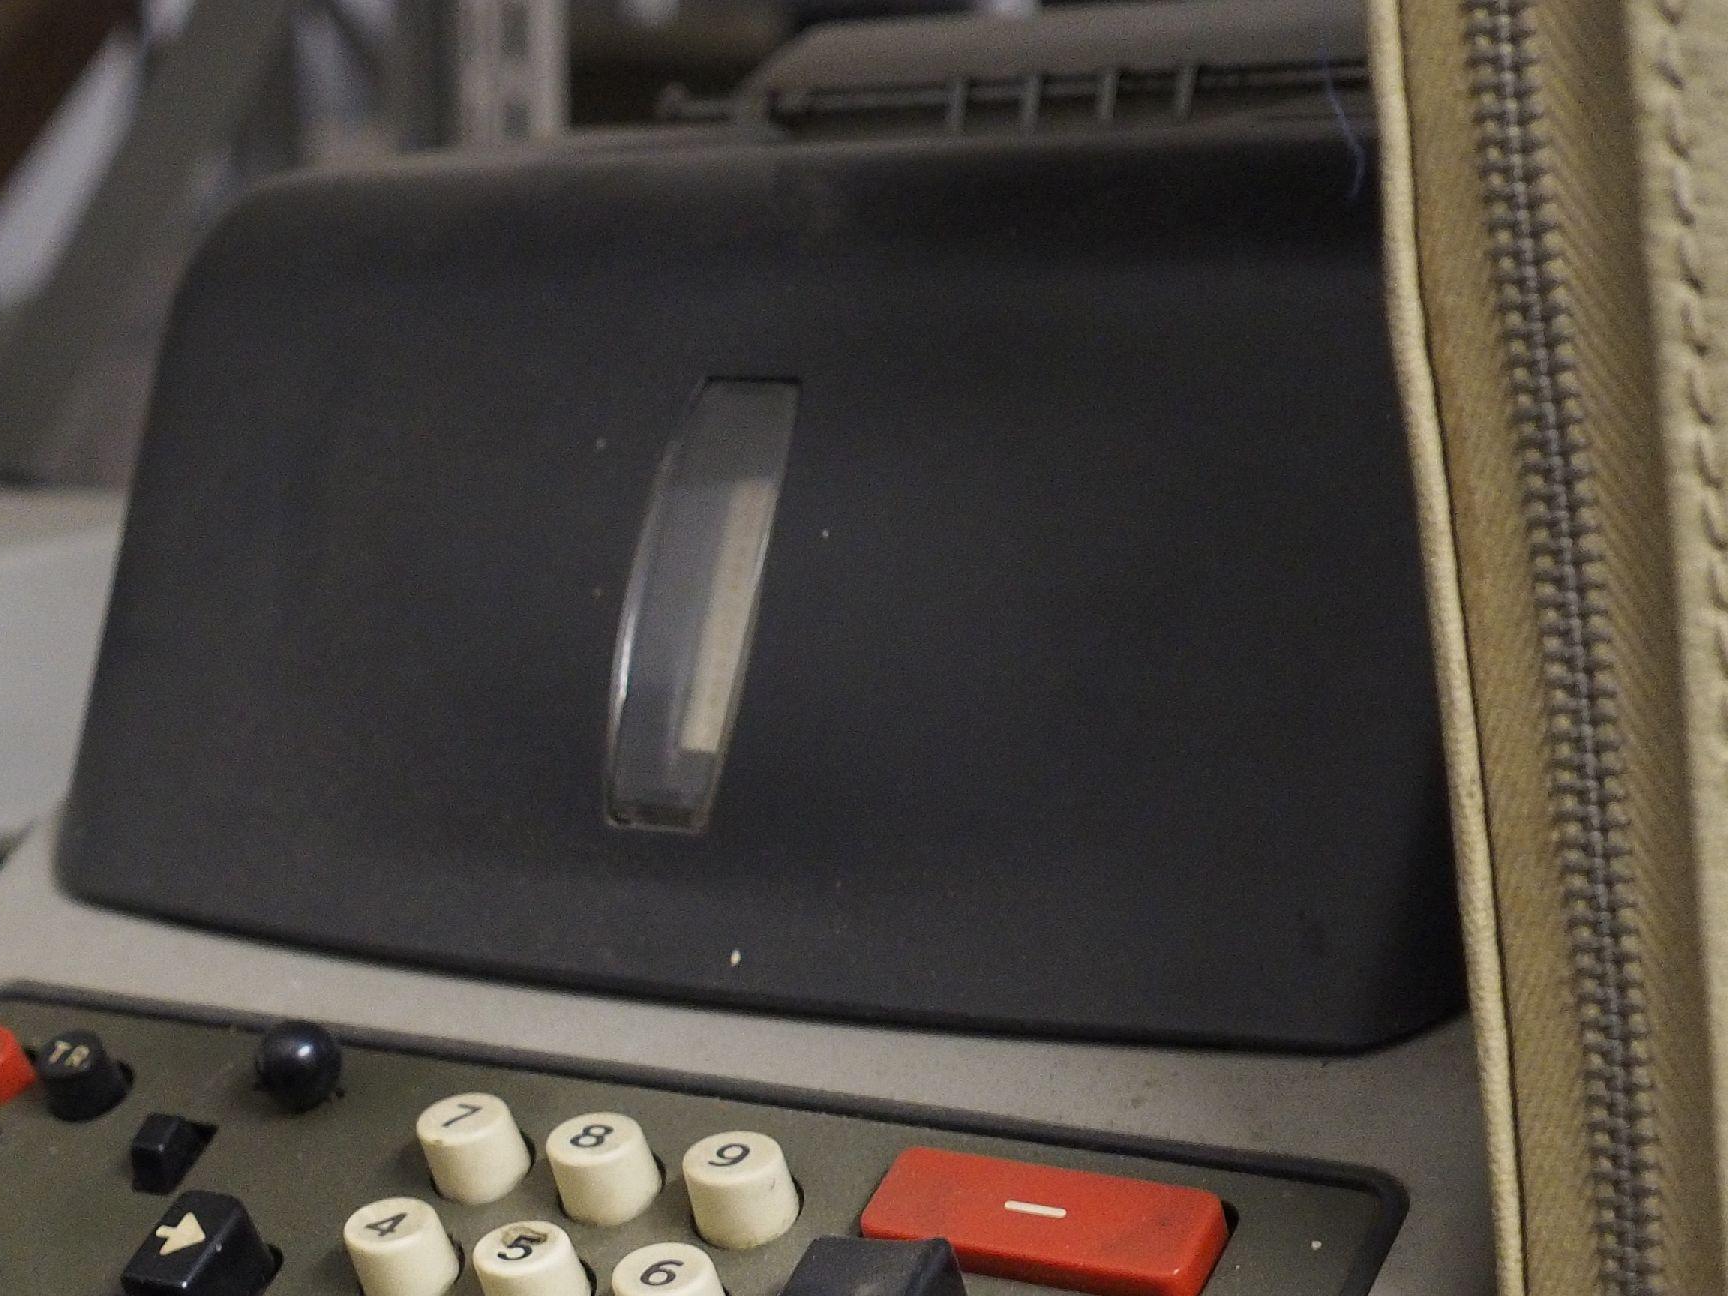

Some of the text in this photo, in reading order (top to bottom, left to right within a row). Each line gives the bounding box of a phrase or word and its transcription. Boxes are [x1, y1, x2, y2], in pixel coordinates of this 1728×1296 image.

[442, 1103, 482, 1127] 7
[569, 1124, 614, 1147] 8
[708, 1142, 750, 1168] 9
[365, 1212, 407, 1237] 4
[497, 1235, 542, 1261] 5
[640, 1259, 683, 1286] 6
